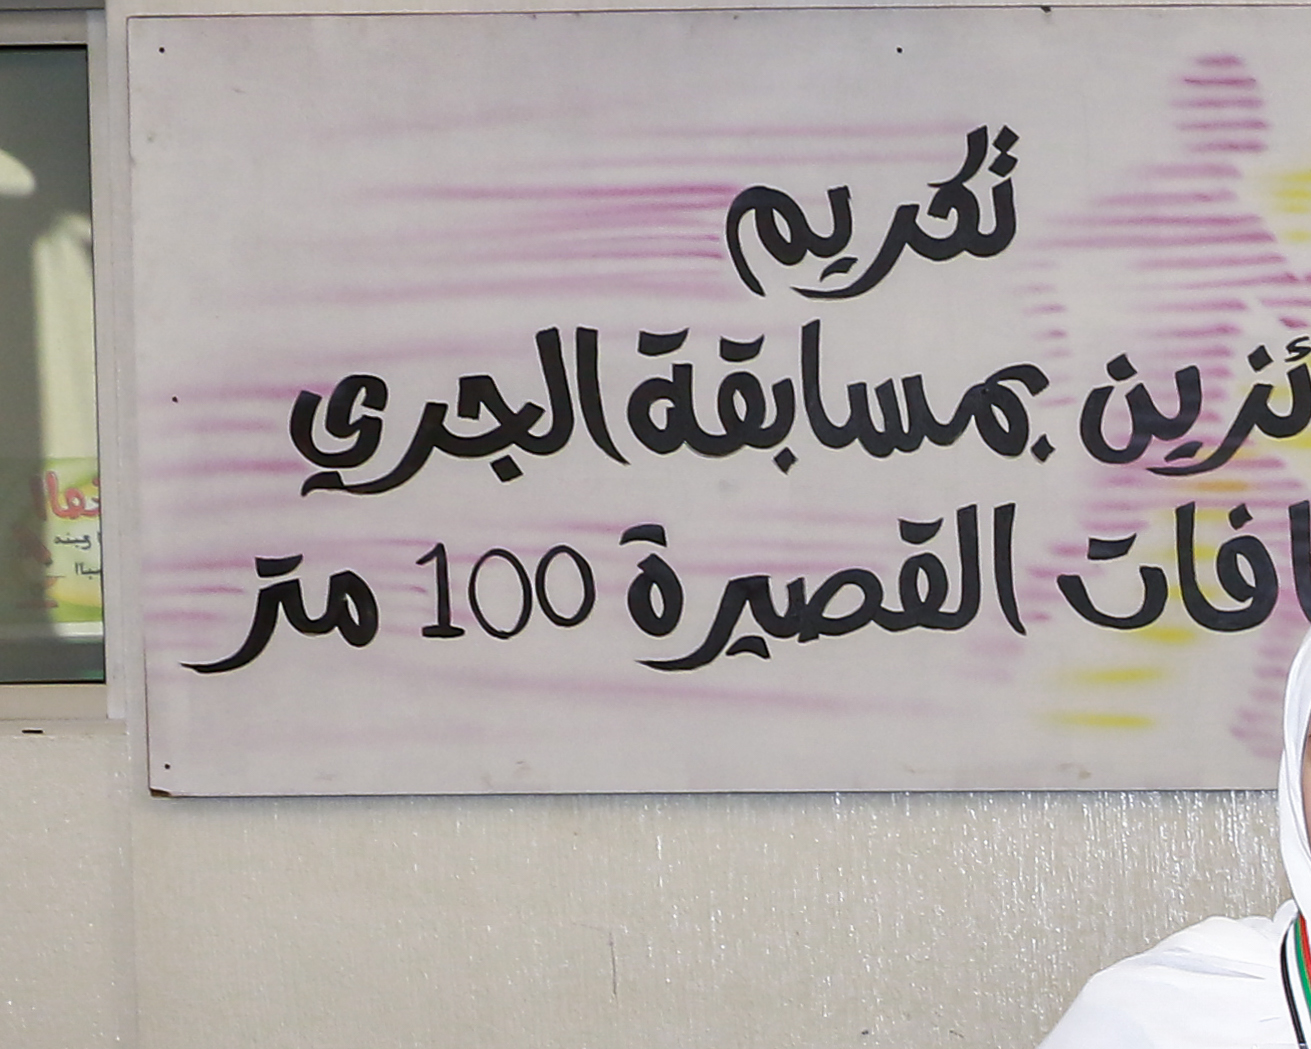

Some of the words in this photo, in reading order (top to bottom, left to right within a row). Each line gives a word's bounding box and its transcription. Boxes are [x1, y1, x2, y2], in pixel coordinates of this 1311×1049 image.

[725, 125, 1020, 300] تكريم
[288, 326, 631, 498] الجري
[625, 319, 1057, 475] بمسابقة
[179, 553, 380, 674] متر
[415, 542, 597, 640] 100
[619, 502, 1028, 673] القصيرة
